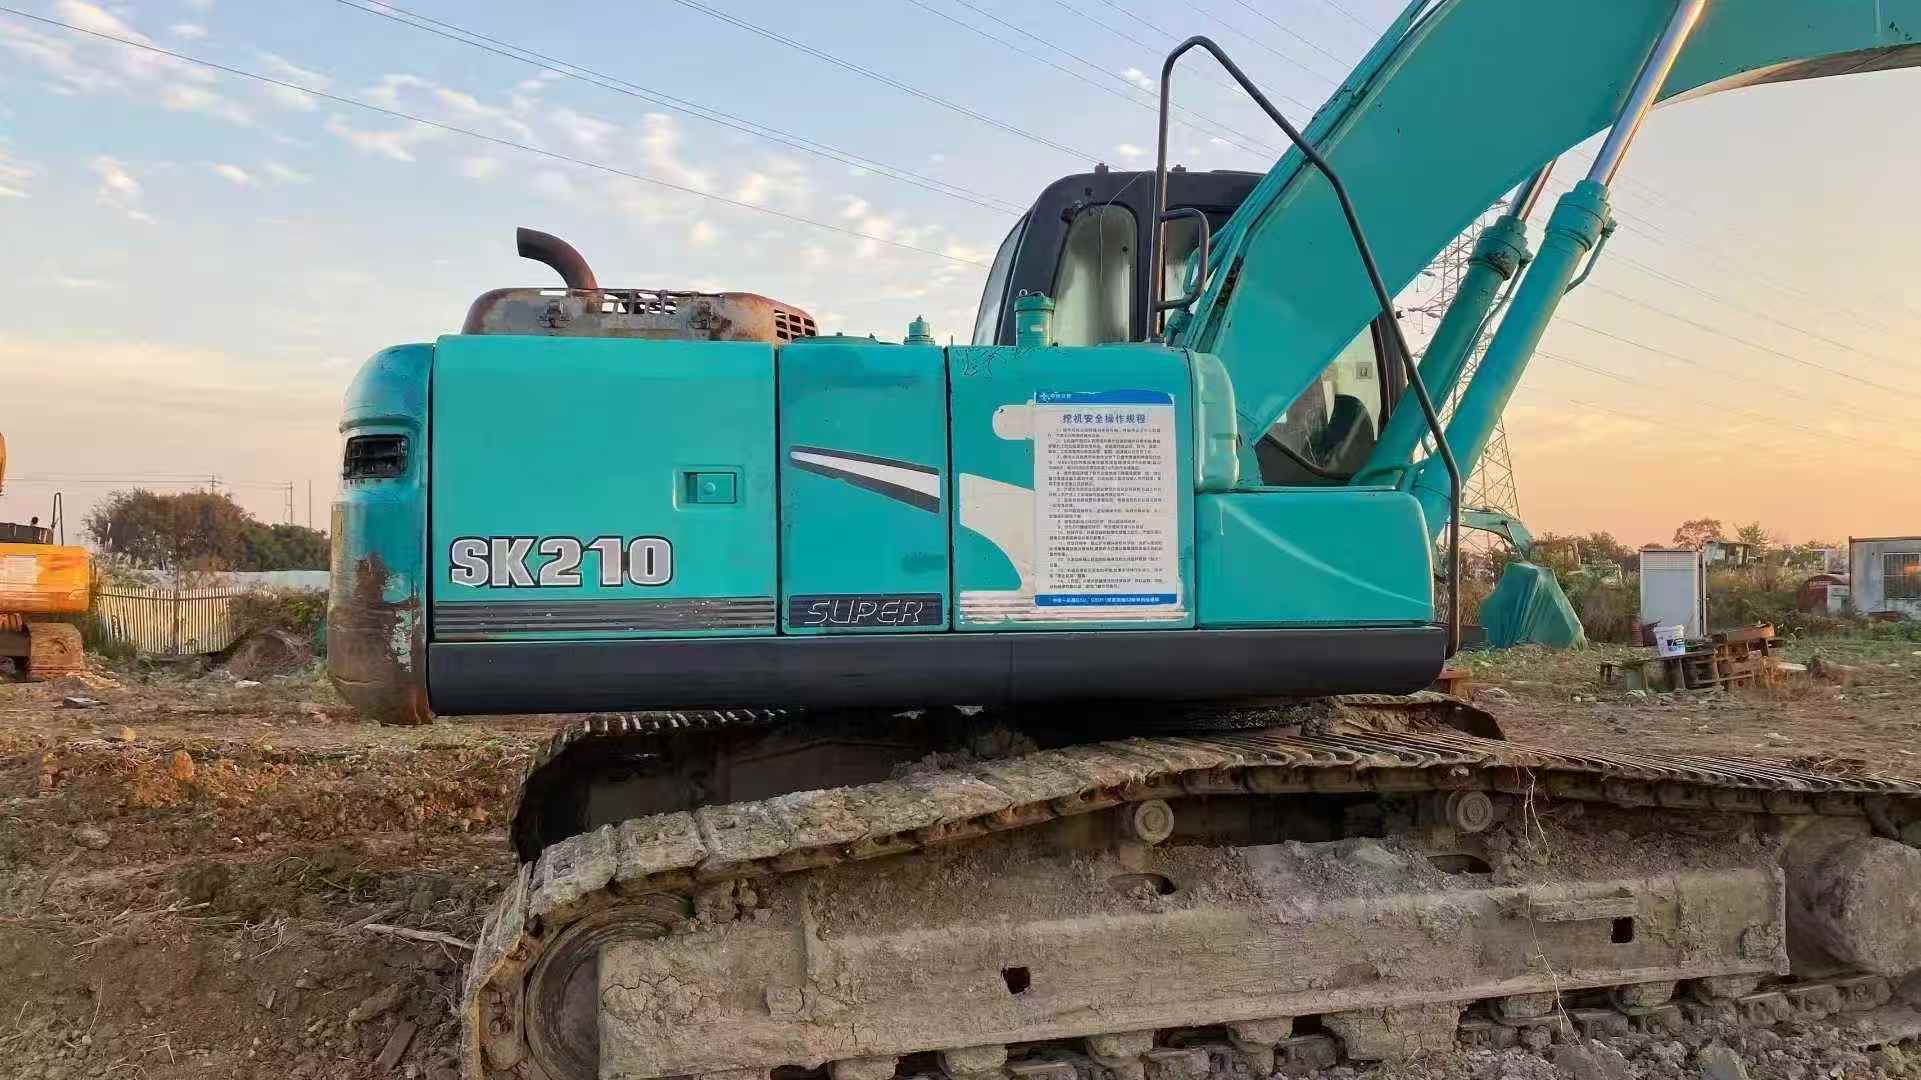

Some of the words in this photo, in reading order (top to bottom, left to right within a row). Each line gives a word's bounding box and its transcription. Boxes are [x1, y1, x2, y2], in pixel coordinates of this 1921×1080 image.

[1062, 413, 1146, 424] 挖机安全操作规程
[450, 536, 673, 588] SK210
[803, 599, 924, 625] SUPER
